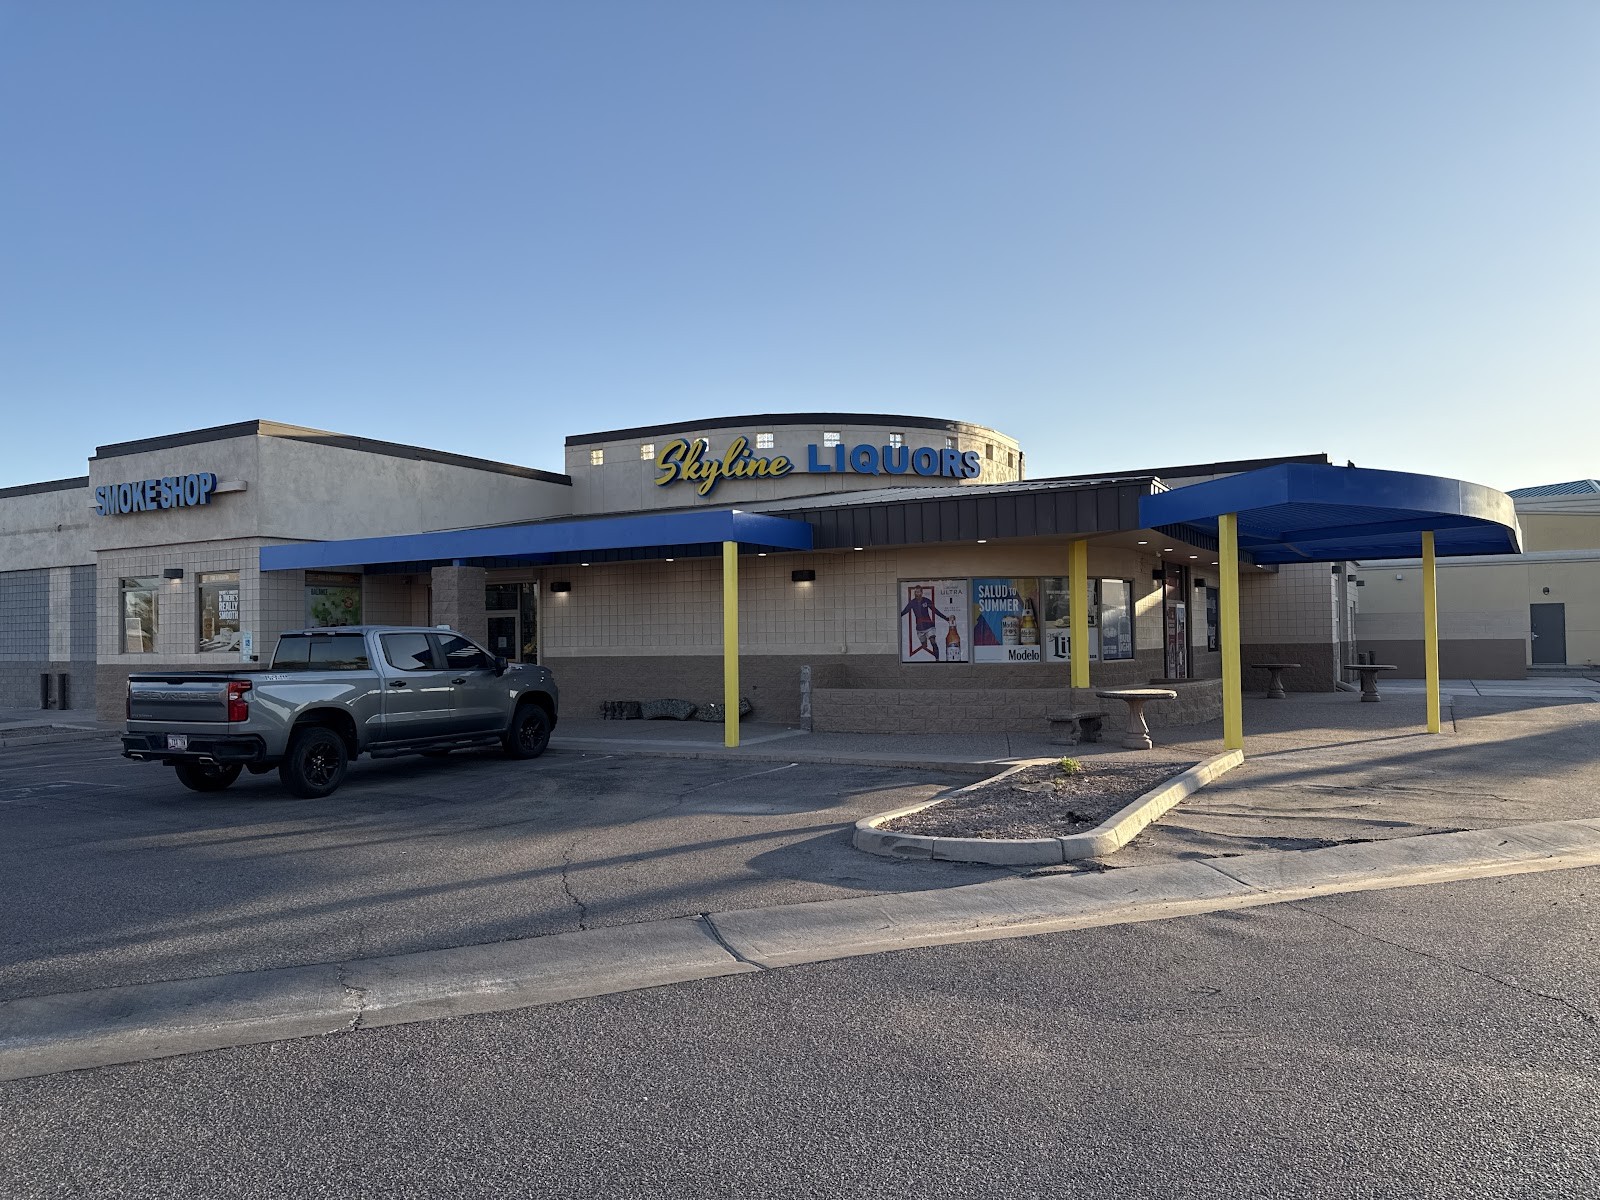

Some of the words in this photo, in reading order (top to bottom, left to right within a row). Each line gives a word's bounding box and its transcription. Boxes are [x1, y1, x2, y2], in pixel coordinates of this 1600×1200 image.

[654, 436, 796, 497] Skyline
[808, 443, 981, 479] LIQUORS
[95, 479, 158, 516] SMOKE
[160, 472, 217, 509] SHOP
[978, 584, 1007, 599] SALUD
[1008, 587, 1017, 597] TO
[218, 601, 238, 611] REALLY
[978, 598, 1020, 612] SUMMER
[218, 610, 239, 620] SMOOTH
[1008, 649, 1040, 661] Modelo
[133, 691, 219, 700] CHEVROLET
